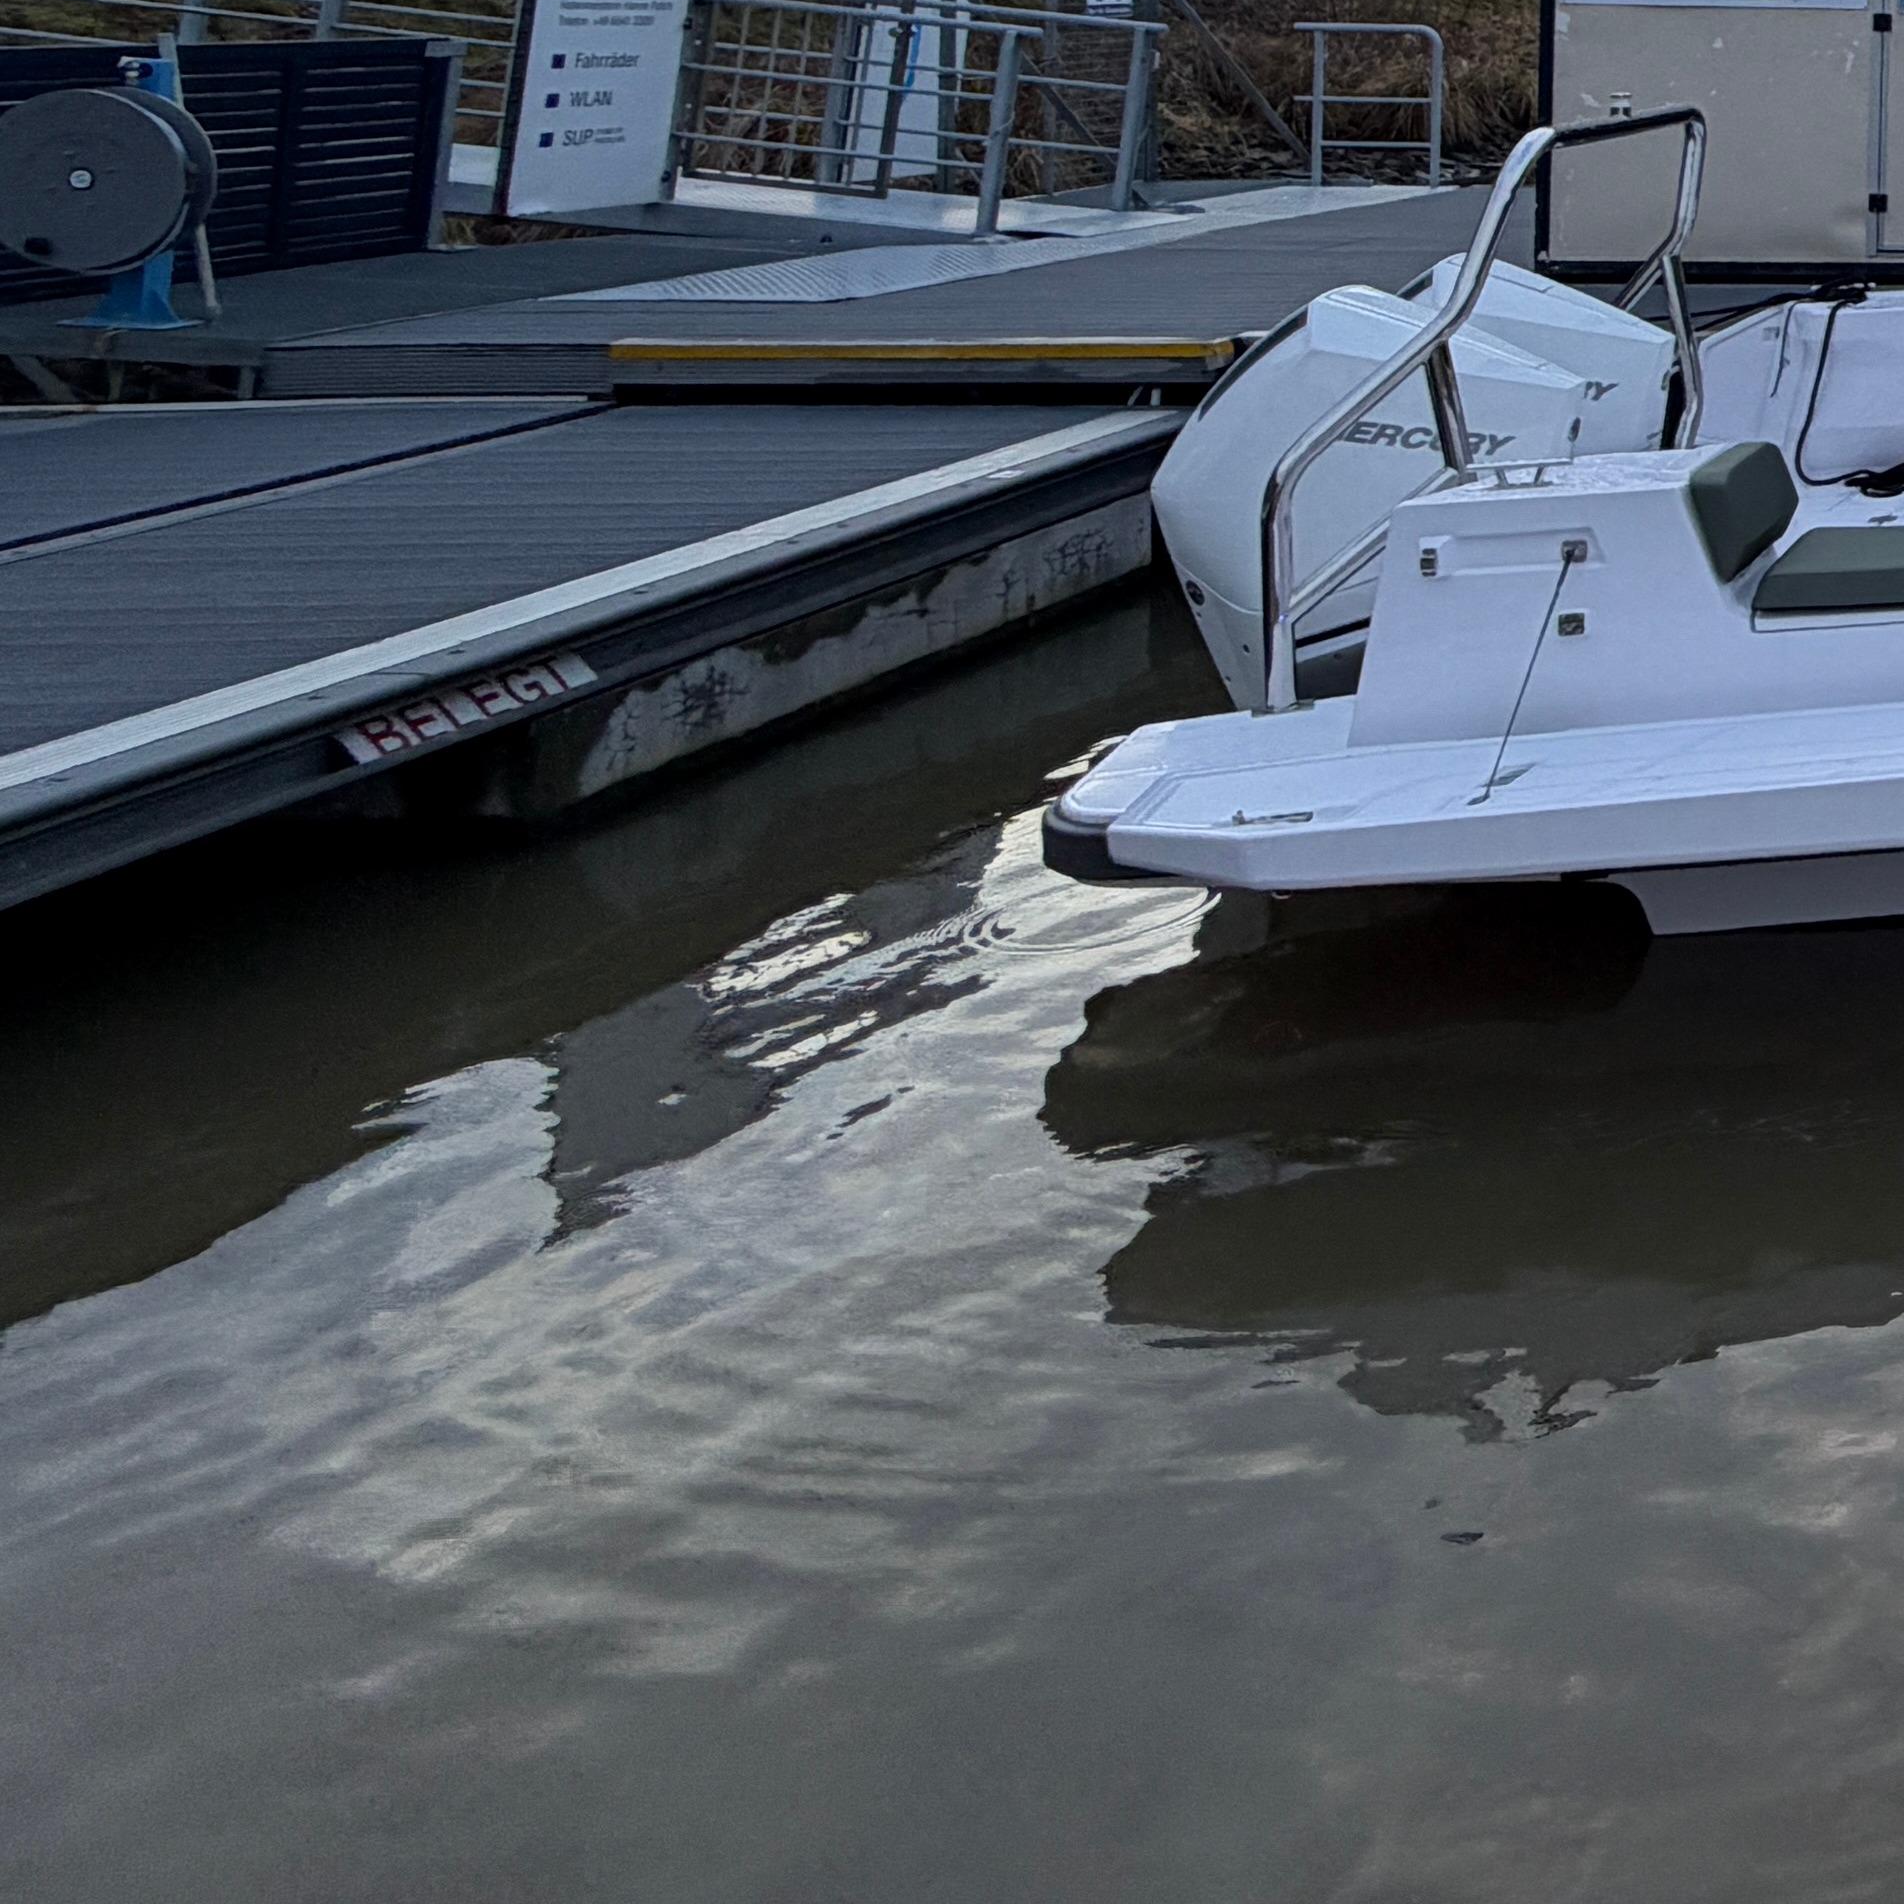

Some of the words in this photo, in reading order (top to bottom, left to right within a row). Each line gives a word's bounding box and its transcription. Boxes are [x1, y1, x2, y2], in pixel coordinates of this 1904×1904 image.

[574, 51, 640, 69] Fahrräder
[569, 90, 614, 108] WLAN
[562, 128, 595, 147] SUP
[1336, 421, 1517, 456] ERCRY
